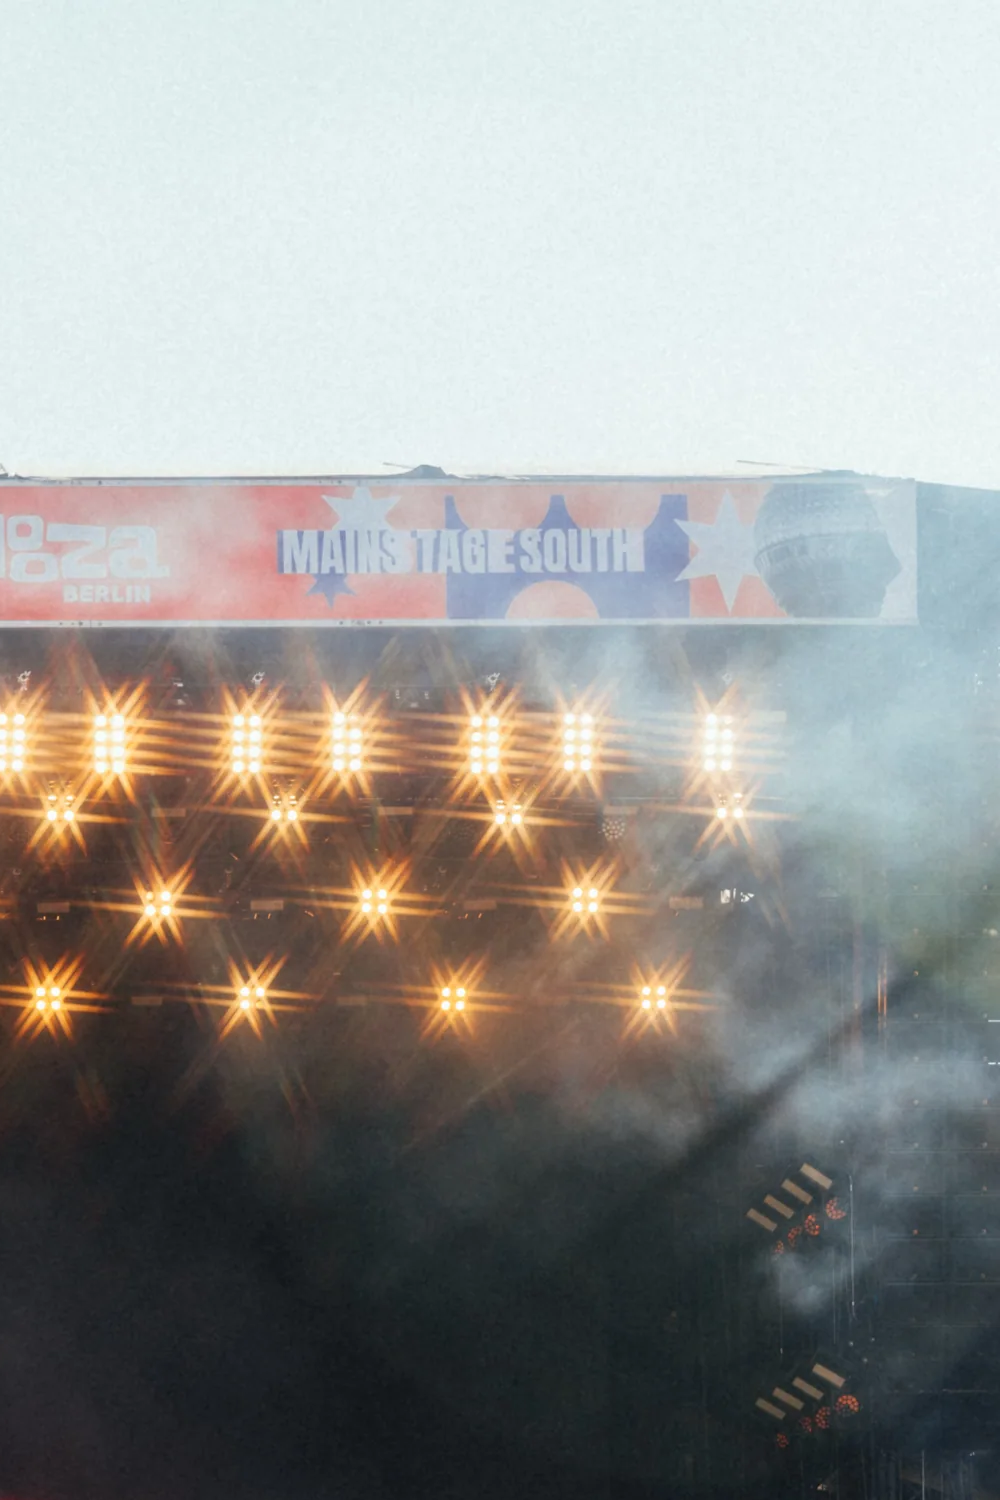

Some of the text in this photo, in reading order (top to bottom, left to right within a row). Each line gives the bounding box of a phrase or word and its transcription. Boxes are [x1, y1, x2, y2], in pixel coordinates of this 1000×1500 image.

[280, 528, 645, 575] MAIN STAGE SOUTH
[62, 585, 151, 604] BERLIN
